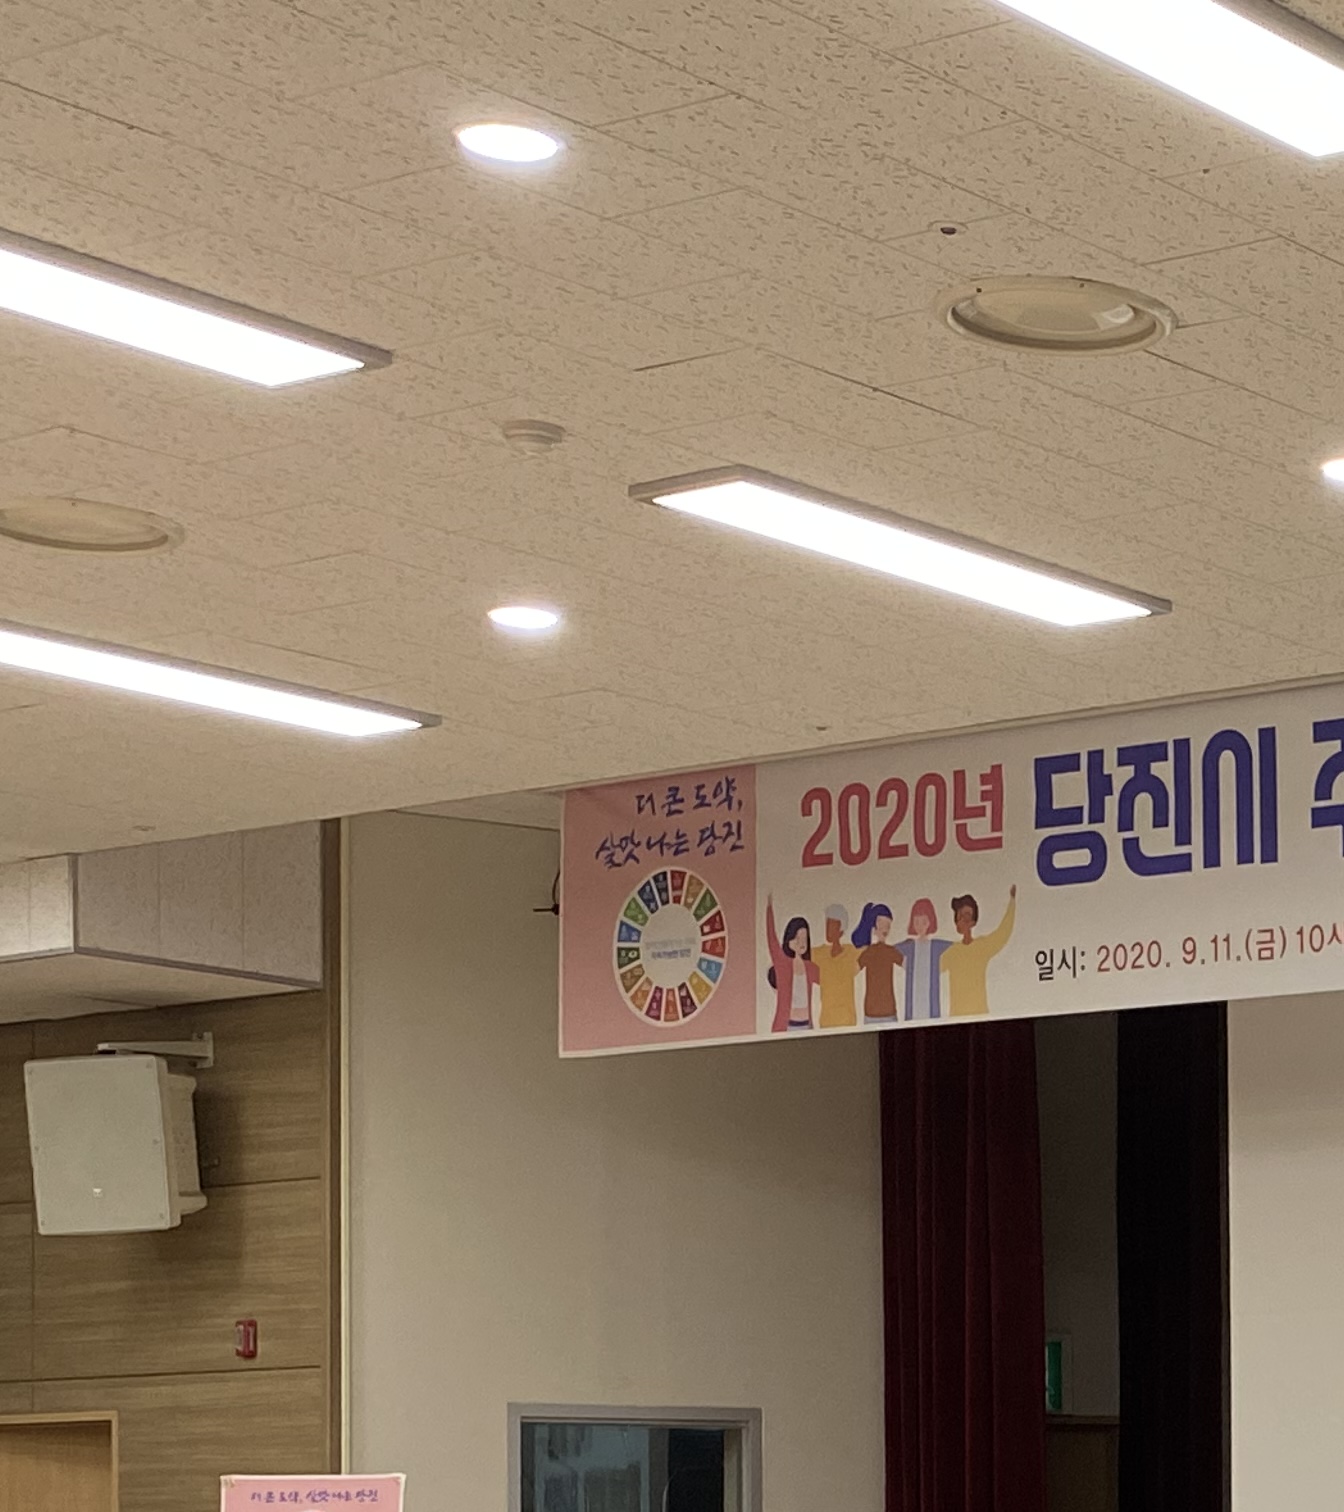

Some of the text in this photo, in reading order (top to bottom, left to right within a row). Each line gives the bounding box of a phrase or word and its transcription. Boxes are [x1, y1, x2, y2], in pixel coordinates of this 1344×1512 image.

[636, 793, 656, 815] 더
[662, 786, 684, 817] 큰
[800, 763, 1004, 869] 2020년
[1032, 726, 1280, 887] 당진시
[697, 820, 745, 857] 당진
[1034, 946, 1088, 980] 일시:
[1096, 940, 1172, 974] 2020.
